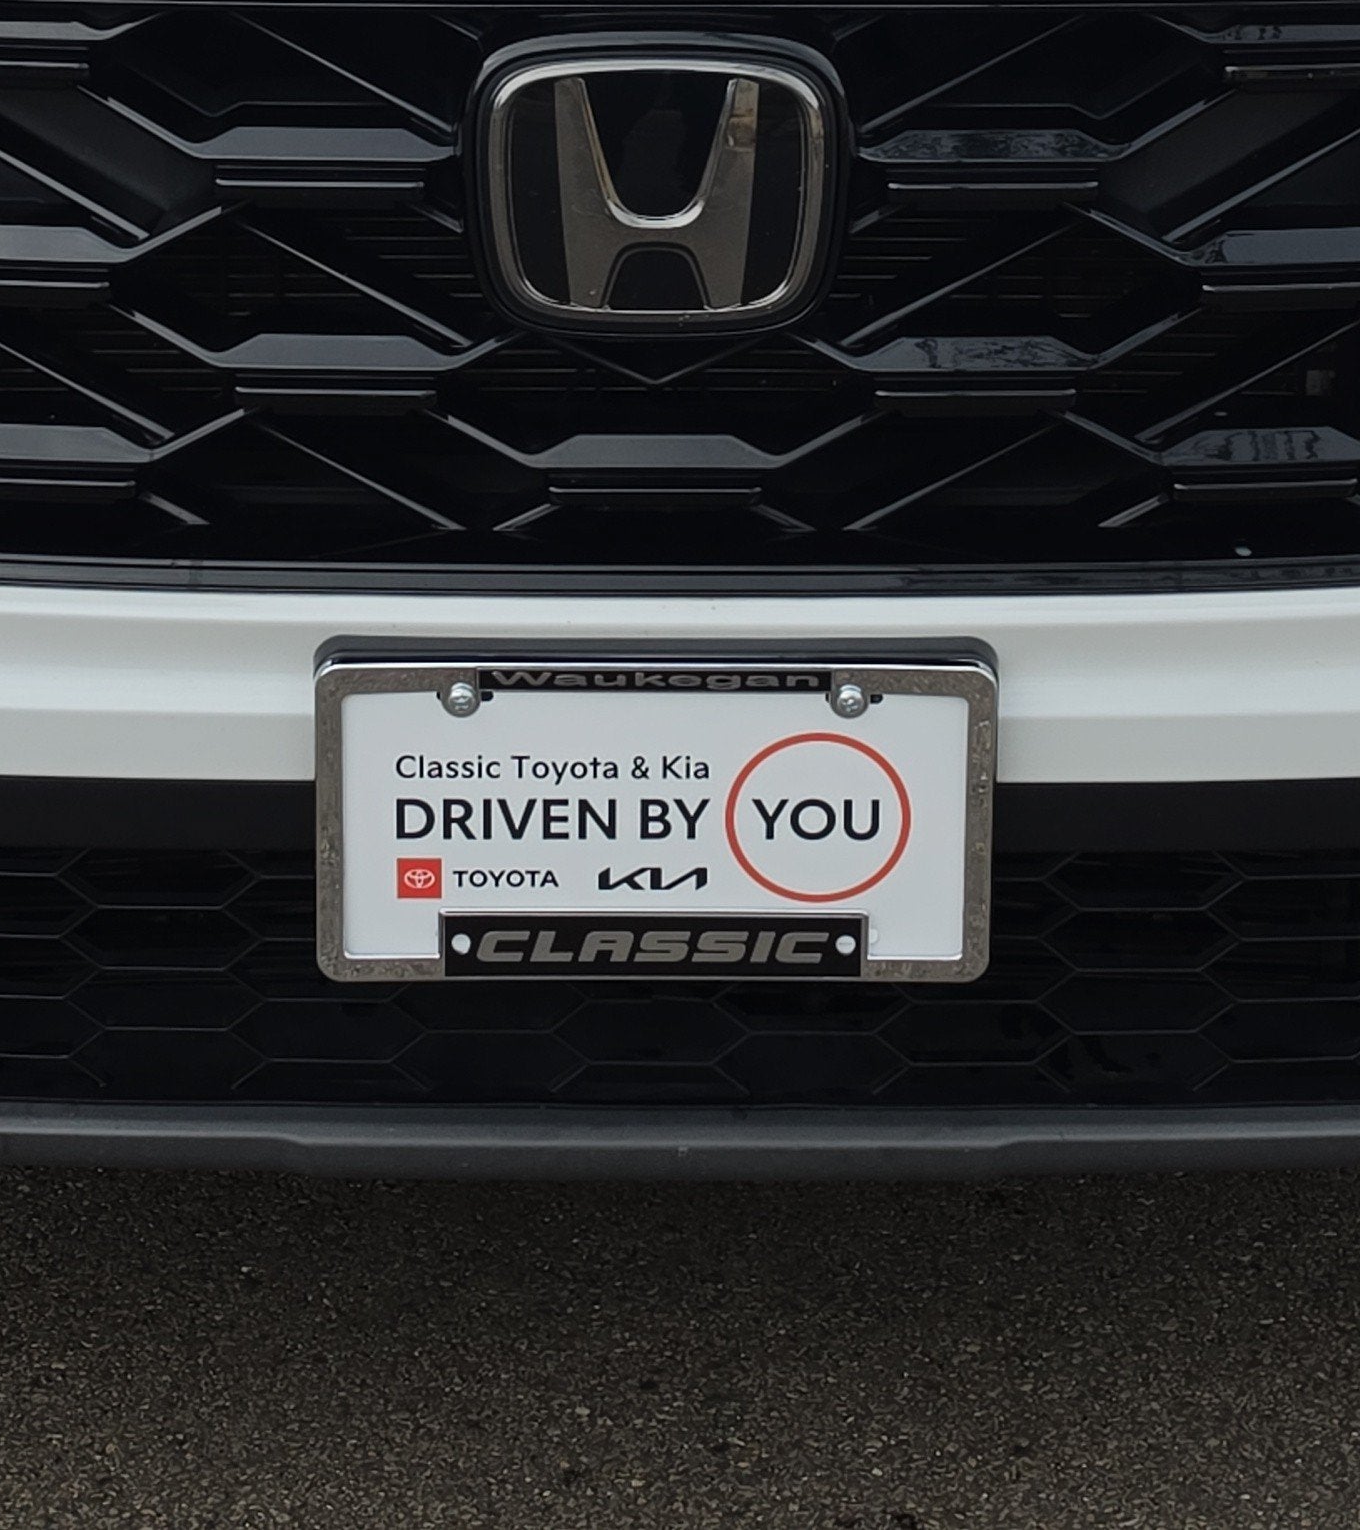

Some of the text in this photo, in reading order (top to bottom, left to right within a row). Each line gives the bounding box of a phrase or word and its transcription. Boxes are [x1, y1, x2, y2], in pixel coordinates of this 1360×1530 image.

[396, 755, 710, 786] Classic Toyota & Kia
[395, 798, 881, 841] DRIVEN BY YOU
[453, 869, 559, 889] TOYOTA
[476, 930, 829, 964] CLASSIC
